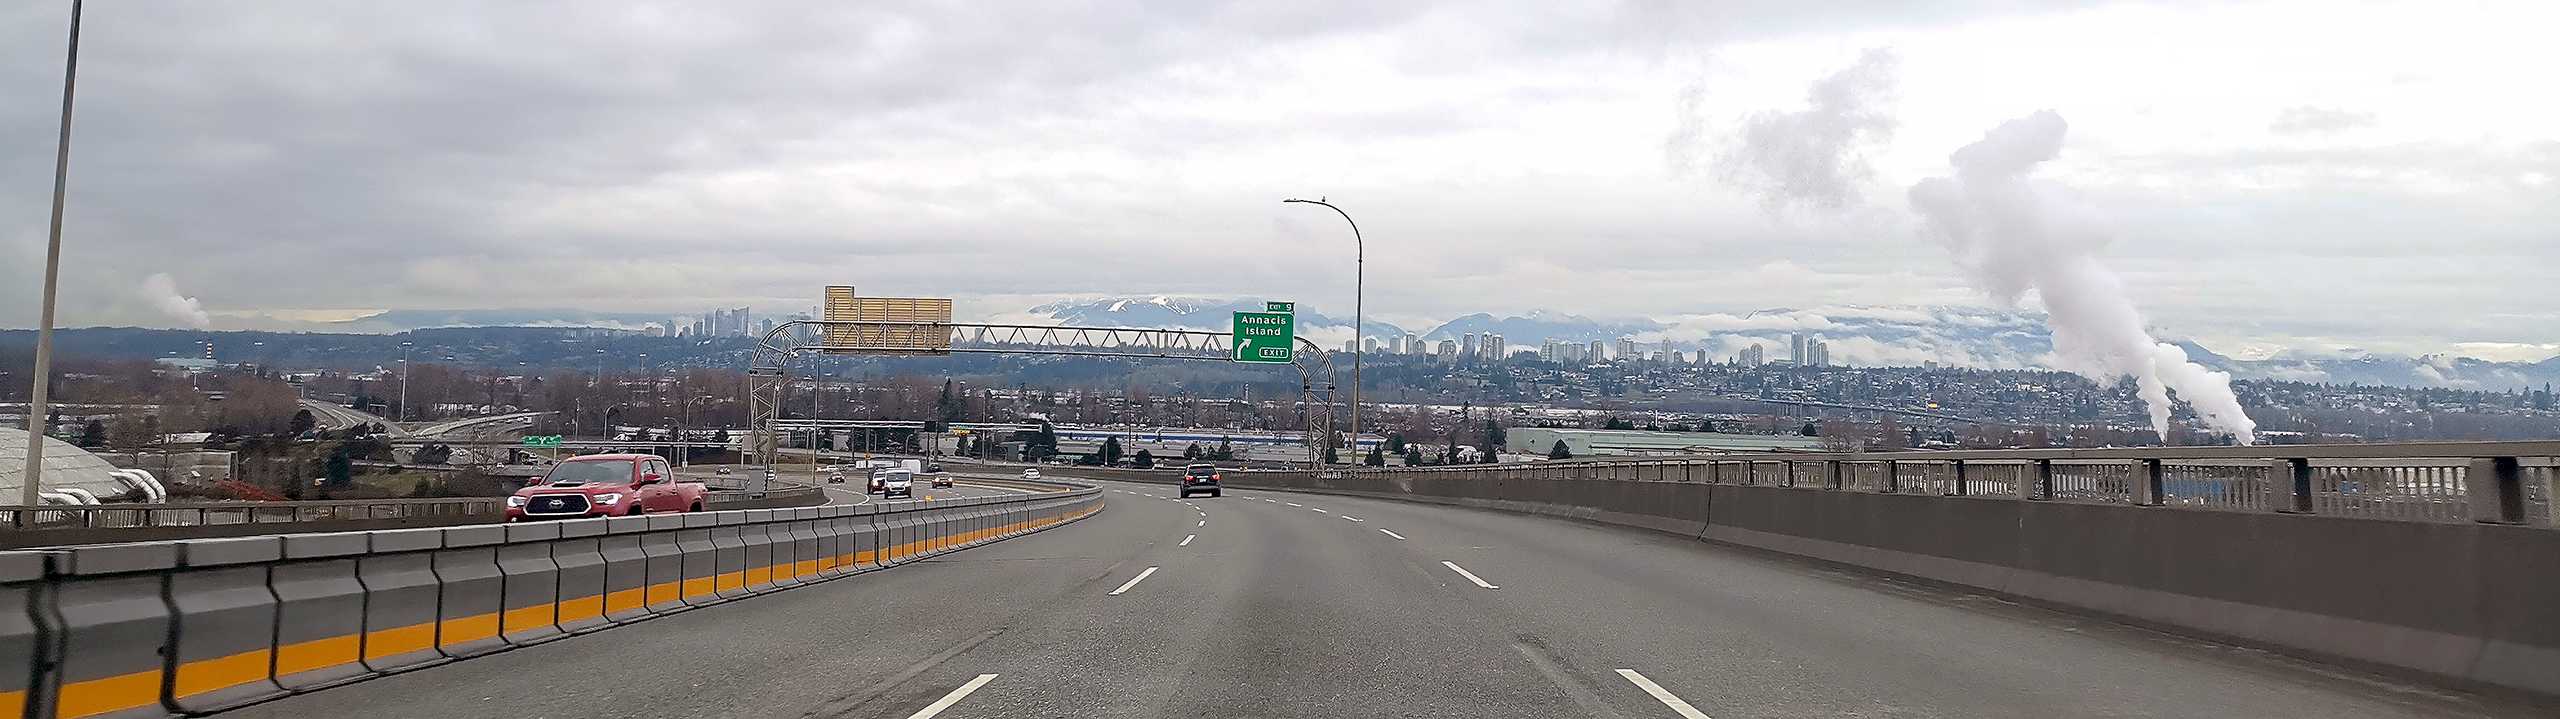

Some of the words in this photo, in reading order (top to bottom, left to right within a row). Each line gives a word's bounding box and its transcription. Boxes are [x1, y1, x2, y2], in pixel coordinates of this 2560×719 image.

[1286, 303, 1292, 311] 9
[1241, 315, 1287, 325] Annacis
[1245, 326, 1281, 336] Island
